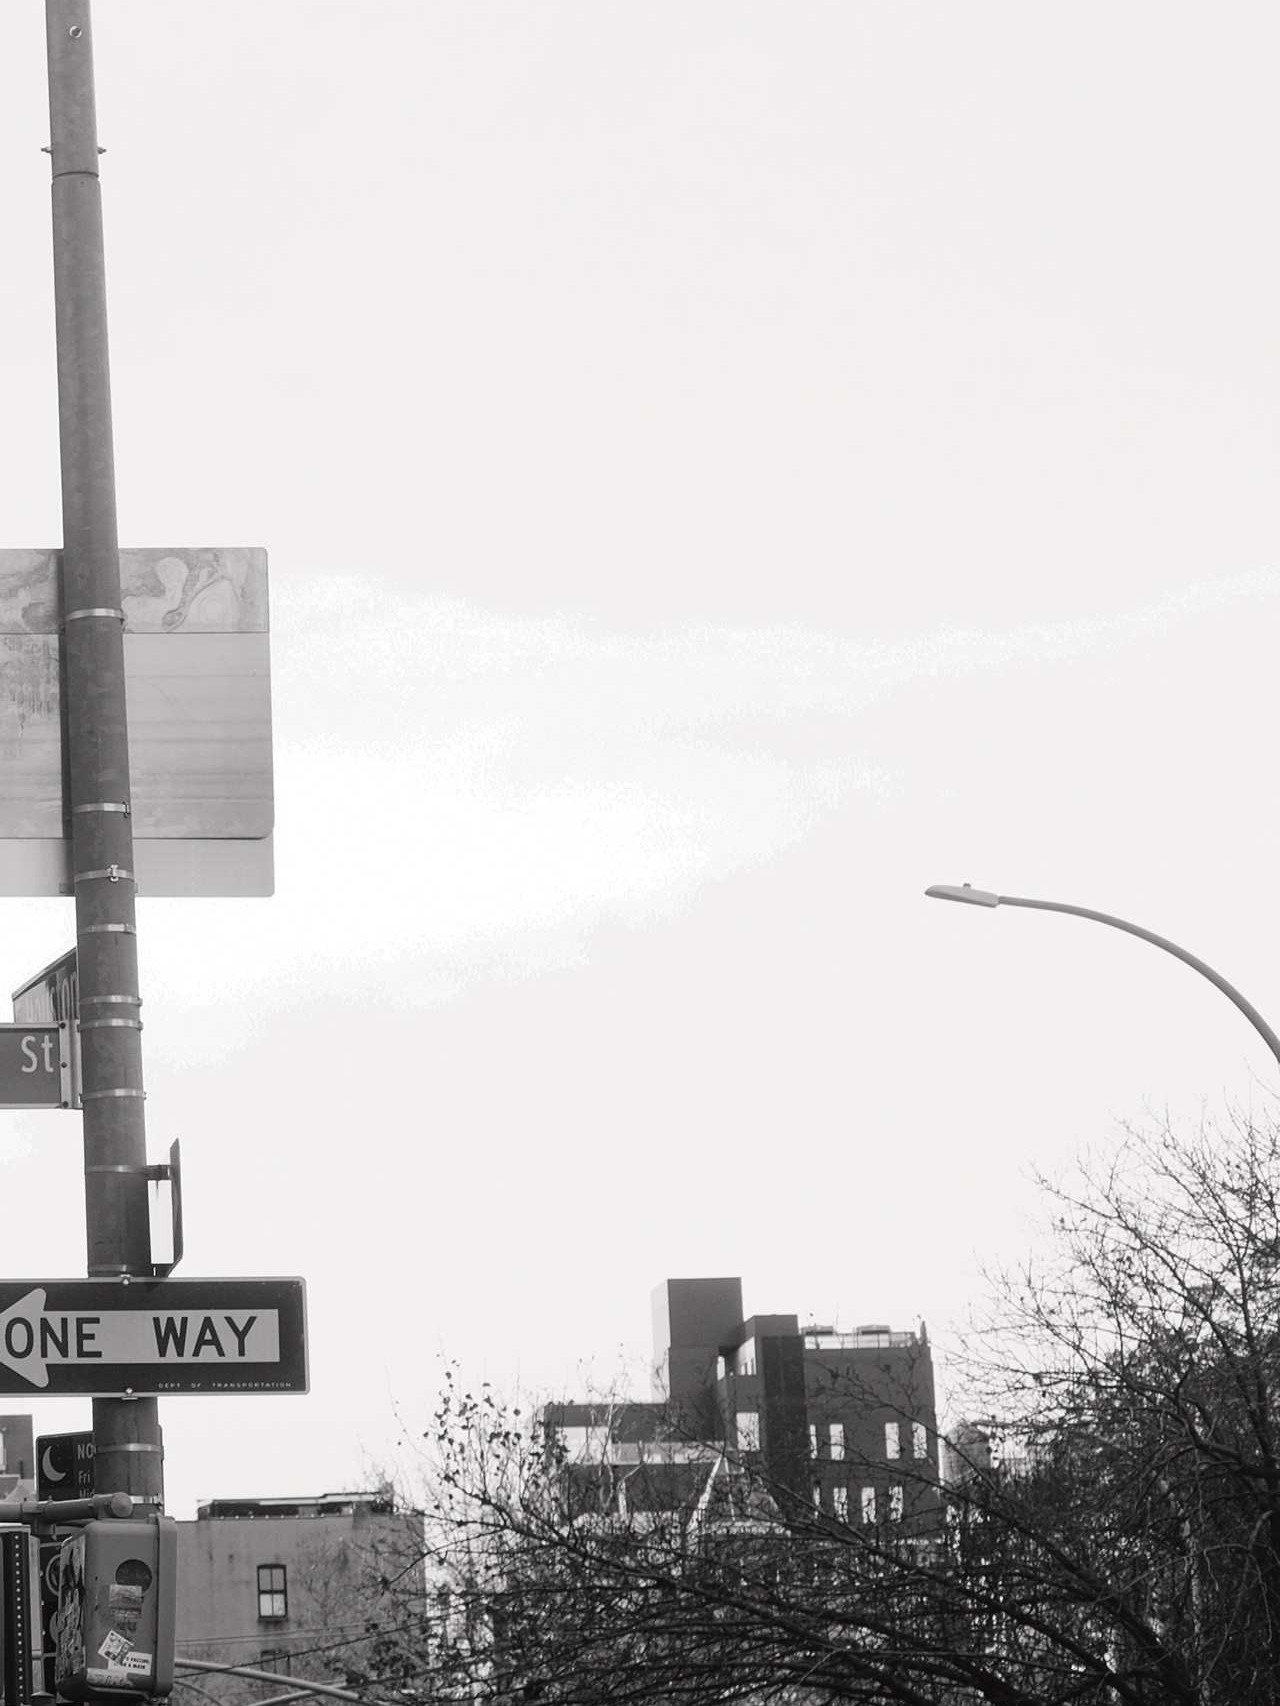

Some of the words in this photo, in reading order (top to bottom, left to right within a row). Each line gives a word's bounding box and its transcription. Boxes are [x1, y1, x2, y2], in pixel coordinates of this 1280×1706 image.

[21, 1035, 54, 1073] St
[4, 1316, 103, 1359] ONE
[152, 1315, 258, 1357] WAY
[212, 1381, 292, 1389] TRANSPORTATION
[77, 1443, 93, 1461] NO
[78, 1470, 91, 1483] Fri
